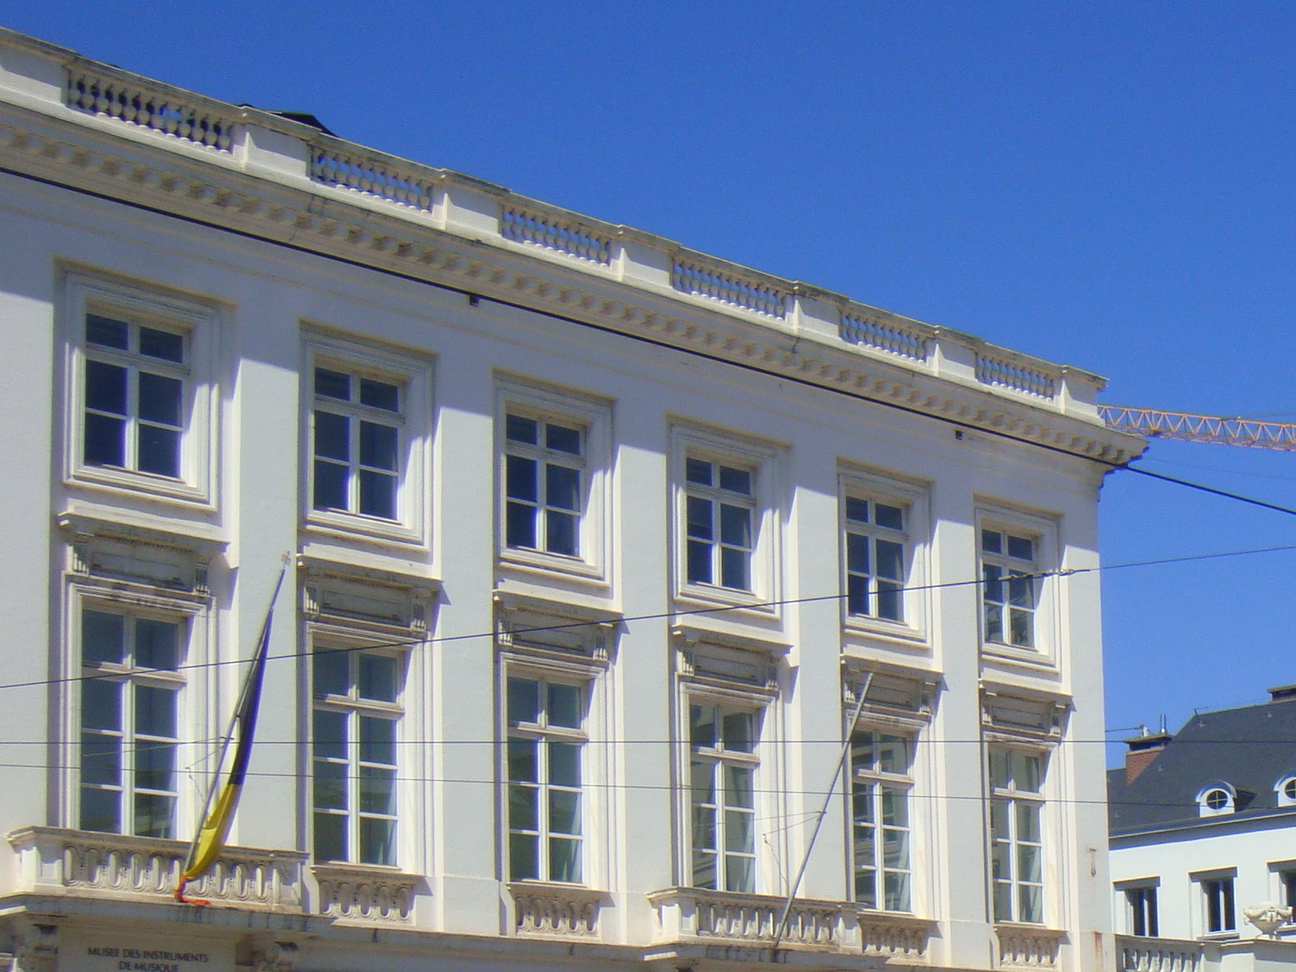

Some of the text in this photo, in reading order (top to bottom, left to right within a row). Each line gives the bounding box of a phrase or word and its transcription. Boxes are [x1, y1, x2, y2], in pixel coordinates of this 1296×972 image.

[123, 948, 140, 959] DES
[143, 950, 209, 963] INSTRUMENTS
[119, 961, 132, 971] DE
